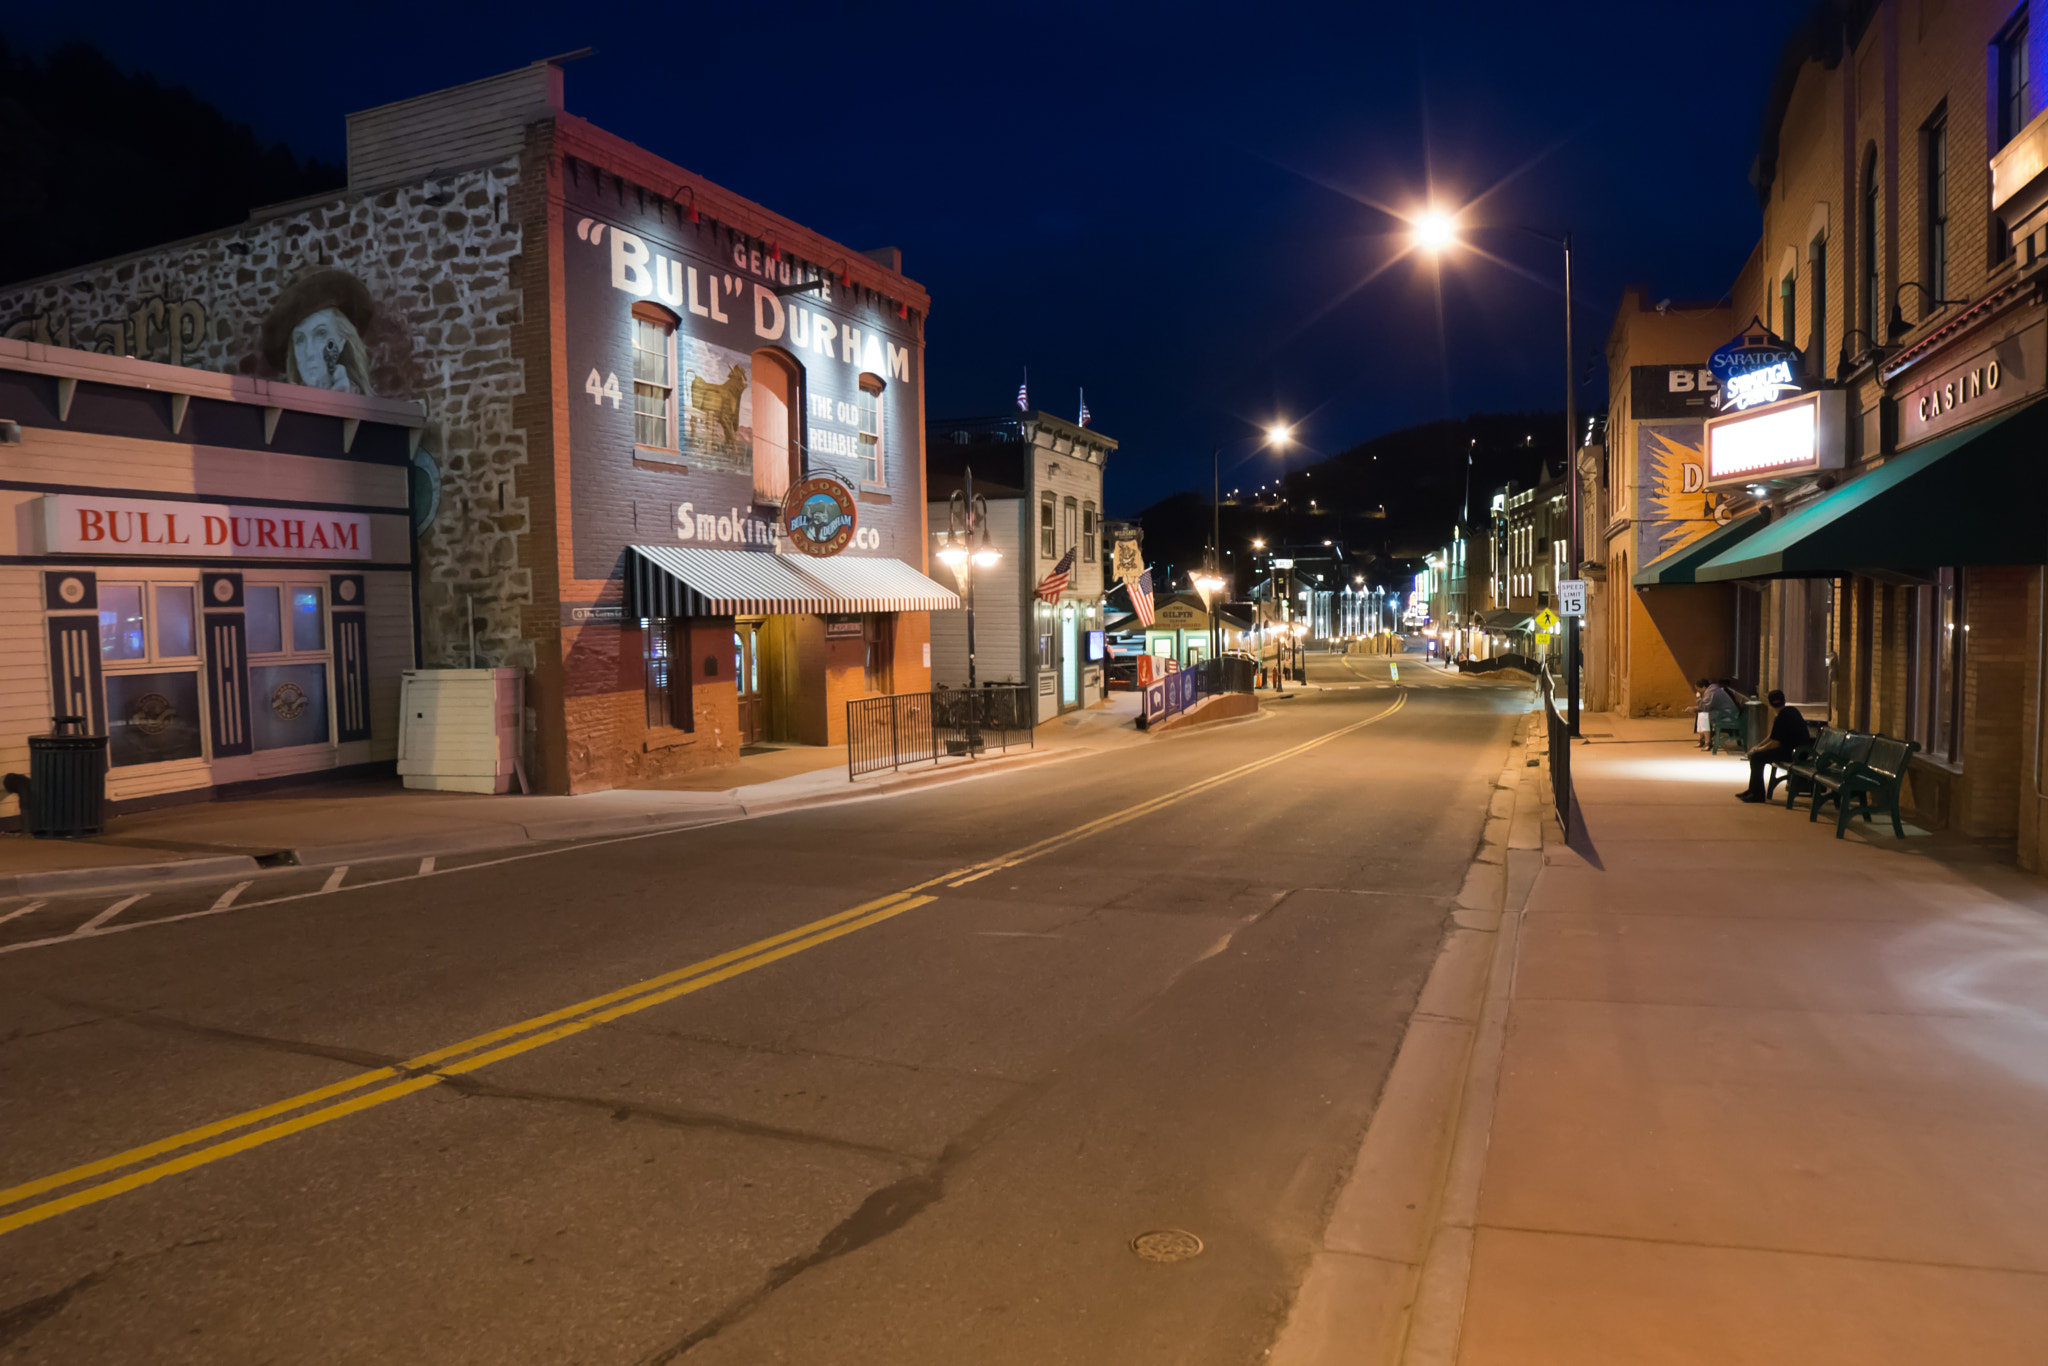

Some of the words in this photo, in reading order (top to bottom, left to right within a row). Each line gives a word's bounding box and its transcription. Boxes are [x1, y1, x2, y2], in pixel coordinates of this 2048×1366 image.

[733, 243, 832, 303] GENUINE
[754, 283, 909, 383] DURHAM
[1714, 351, 1799, 368] SARATOGA
[585, 367, 623, 410] 44
[1669, 369, 1718, 393] BE
[1727, 361, 1793, 399] STOGA
[1919, 360, 1999, 421] CASINO
[810, 393, 833, 420] THE
[837, 401, 859, 426] OLD
[809, 427, 859, 458] RELIABLE
[791, 481, 850, 509] SALOON
[76, 508, 190, 545] BULL
[201, 515, 360, 550] DURHAM
[677, 502, 782, 554] Smoking
[790, 515, 808, 531] BULL
[823, 514, 852, 536] DURHAM
[794, 532, 847, 555] CASINO
[1565, 600, 1582, 612] 15
